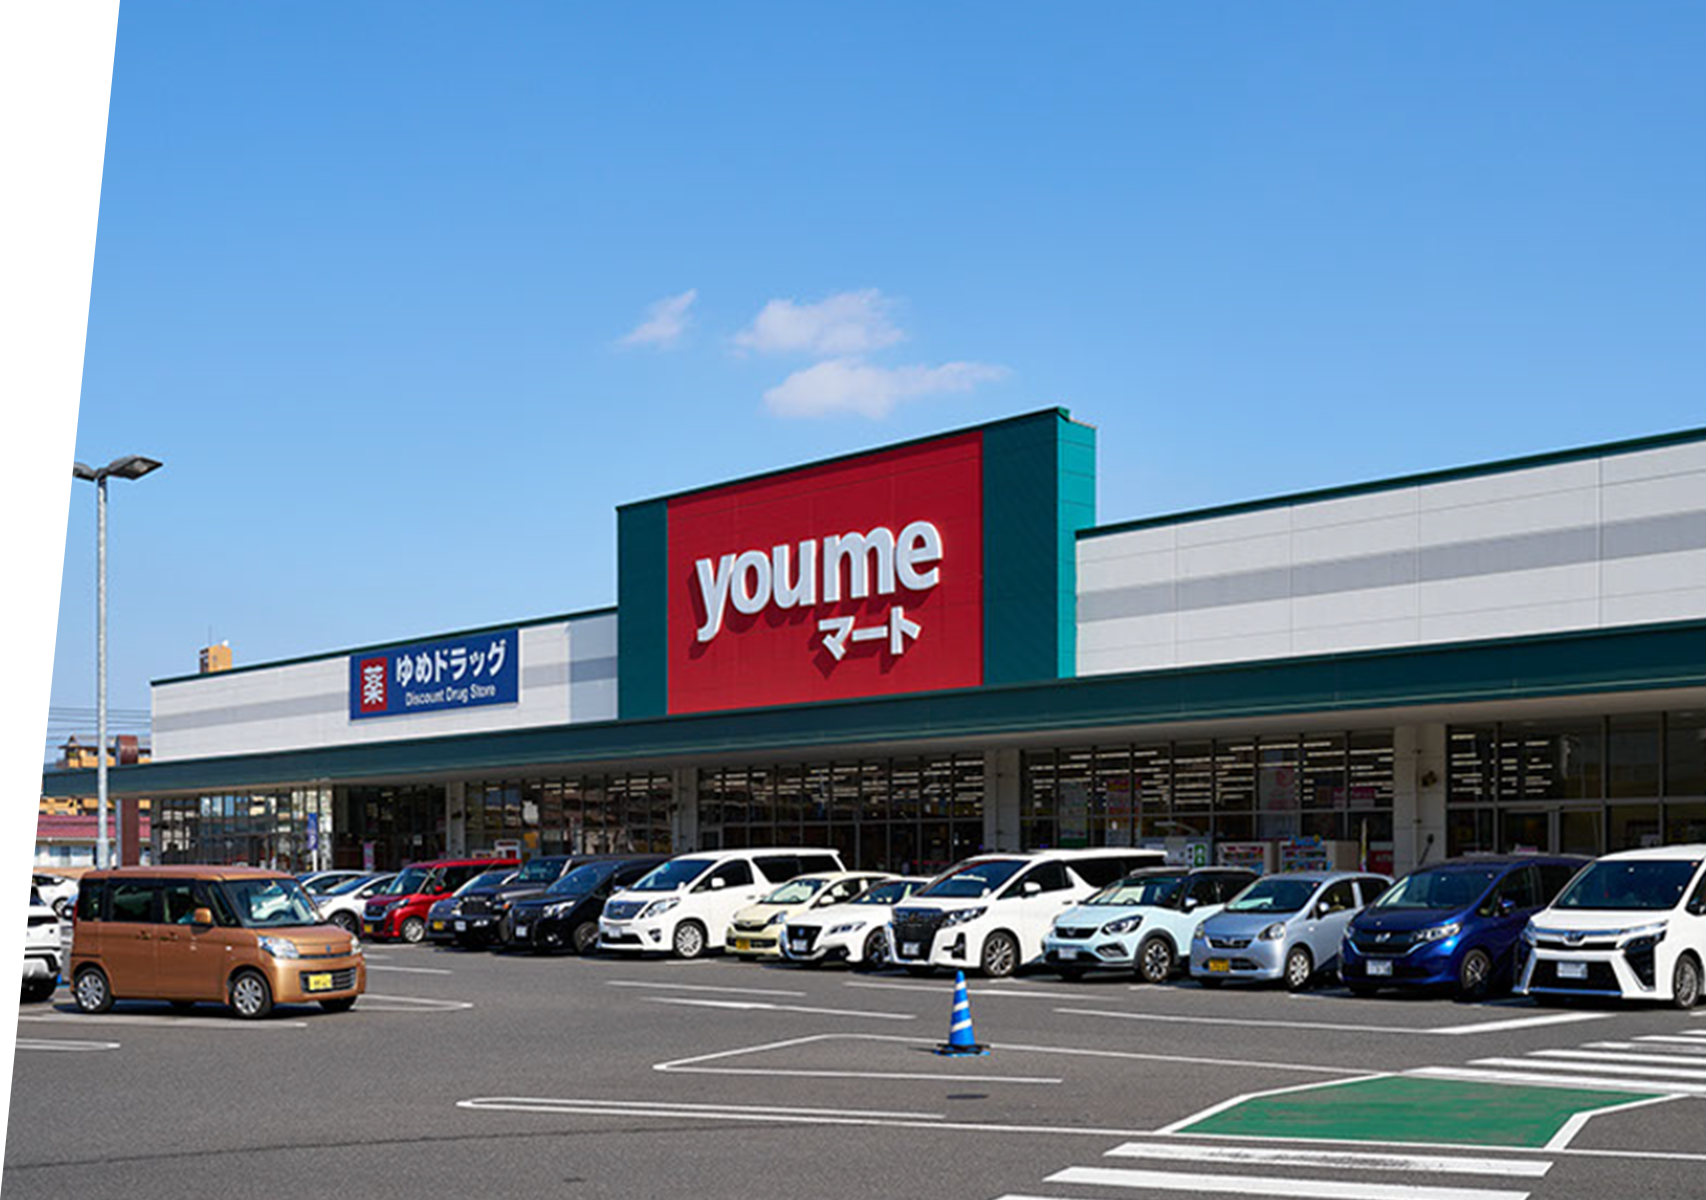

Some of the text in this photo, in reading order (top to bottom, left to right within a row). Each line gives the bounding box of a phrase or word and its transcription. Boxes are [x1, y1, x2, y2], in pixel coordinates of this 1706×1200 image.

[818, 606, 921, 661] マート
[363, 665, 384, 705] 薬
[396, 639, 507, 687] ゆめドラッグ
[405, 682, 496, 706] Discount Drug Store
